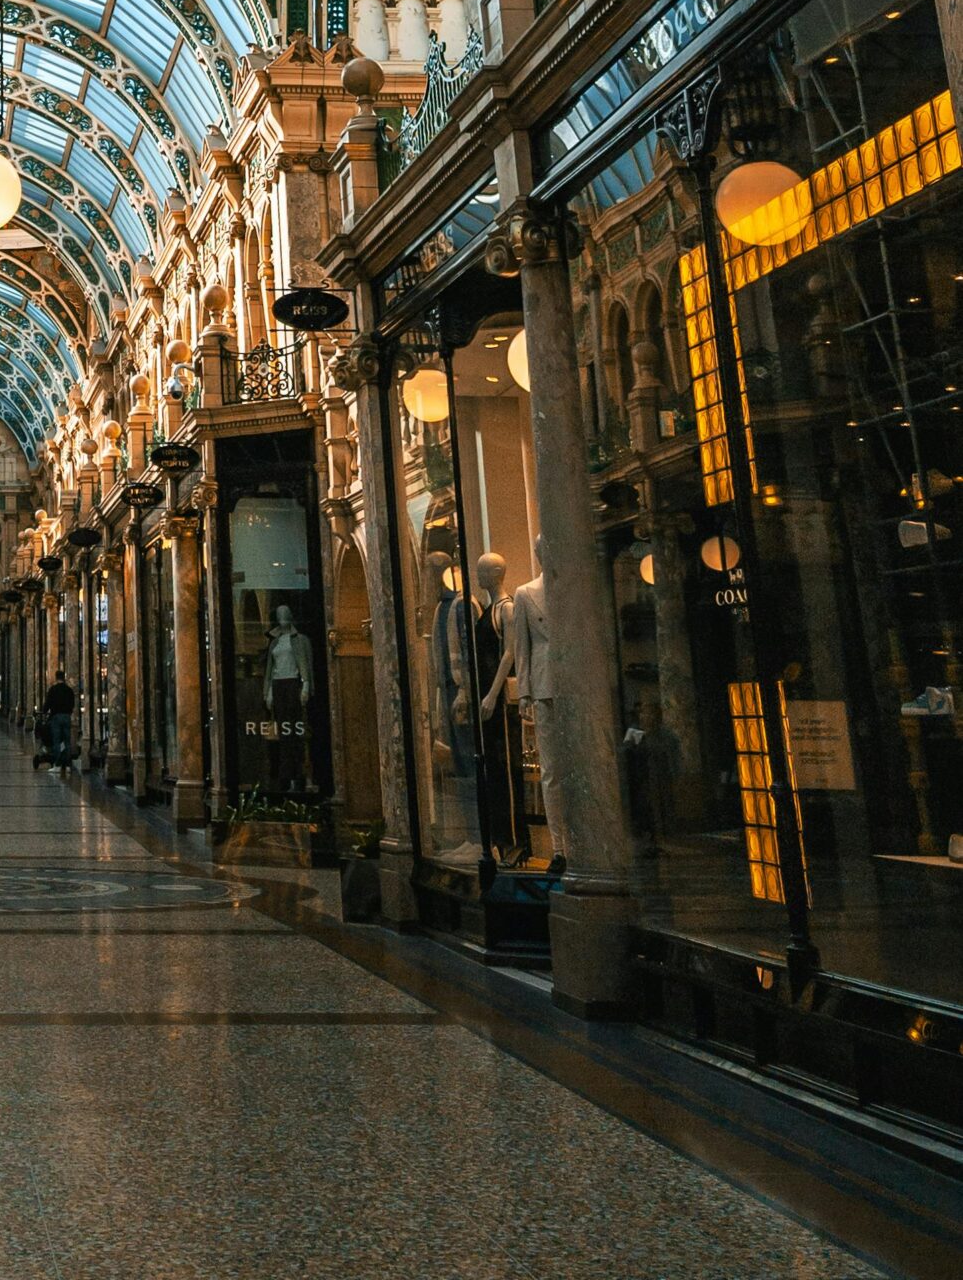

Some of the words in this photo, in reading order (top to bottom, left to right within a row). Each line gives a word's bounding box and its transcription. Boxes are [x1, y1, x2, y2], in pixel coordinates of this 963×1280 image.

[293, 305, 327, 315] REISS
[715, 589, 747, 606] COA
[245, 721, 305, 735] REISS
